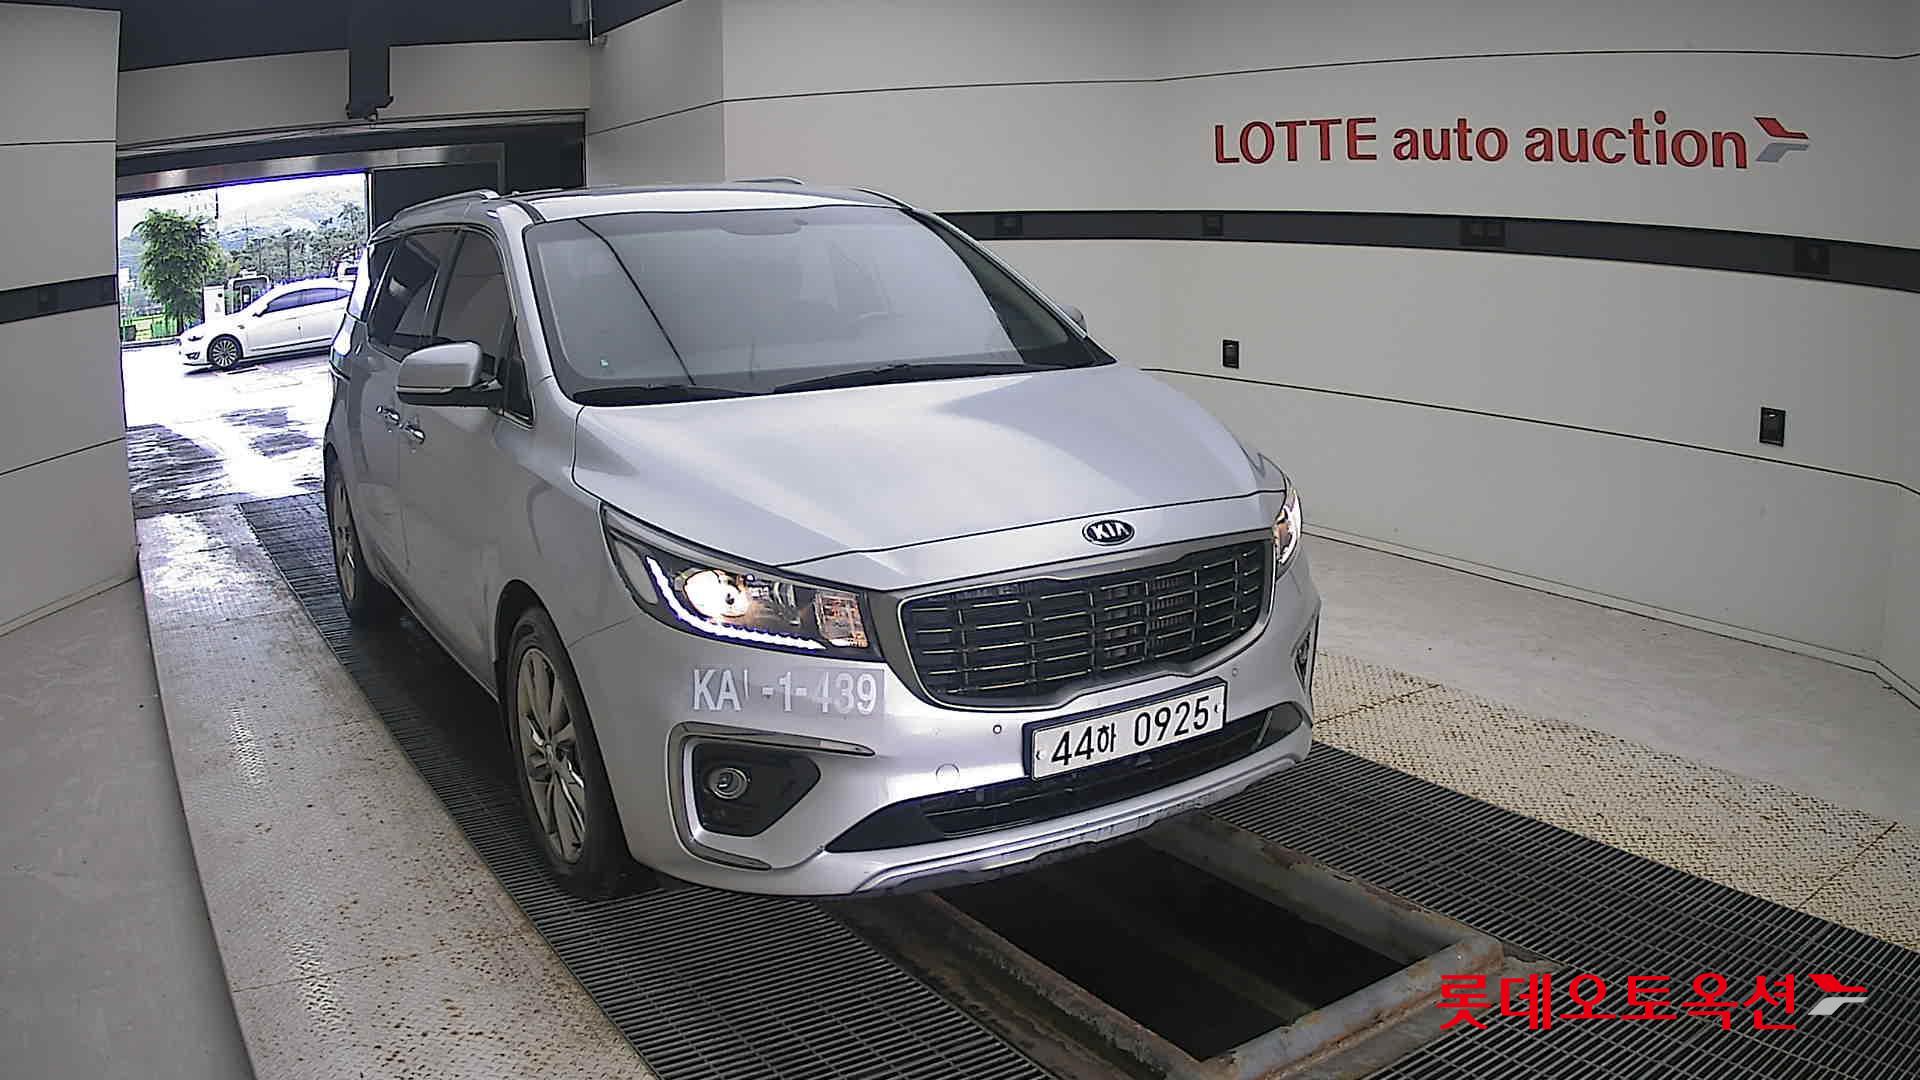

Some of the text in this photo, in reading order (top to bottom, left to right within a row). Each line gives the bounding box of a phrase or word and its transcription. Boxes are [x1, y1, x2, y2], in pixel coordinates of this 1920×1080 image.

[1214, 111, 1748, 168] LOTTE auto auction
[1090, 521, 1130, 540] KIA
[1051, 695, 1210, 766] 44하 0925
